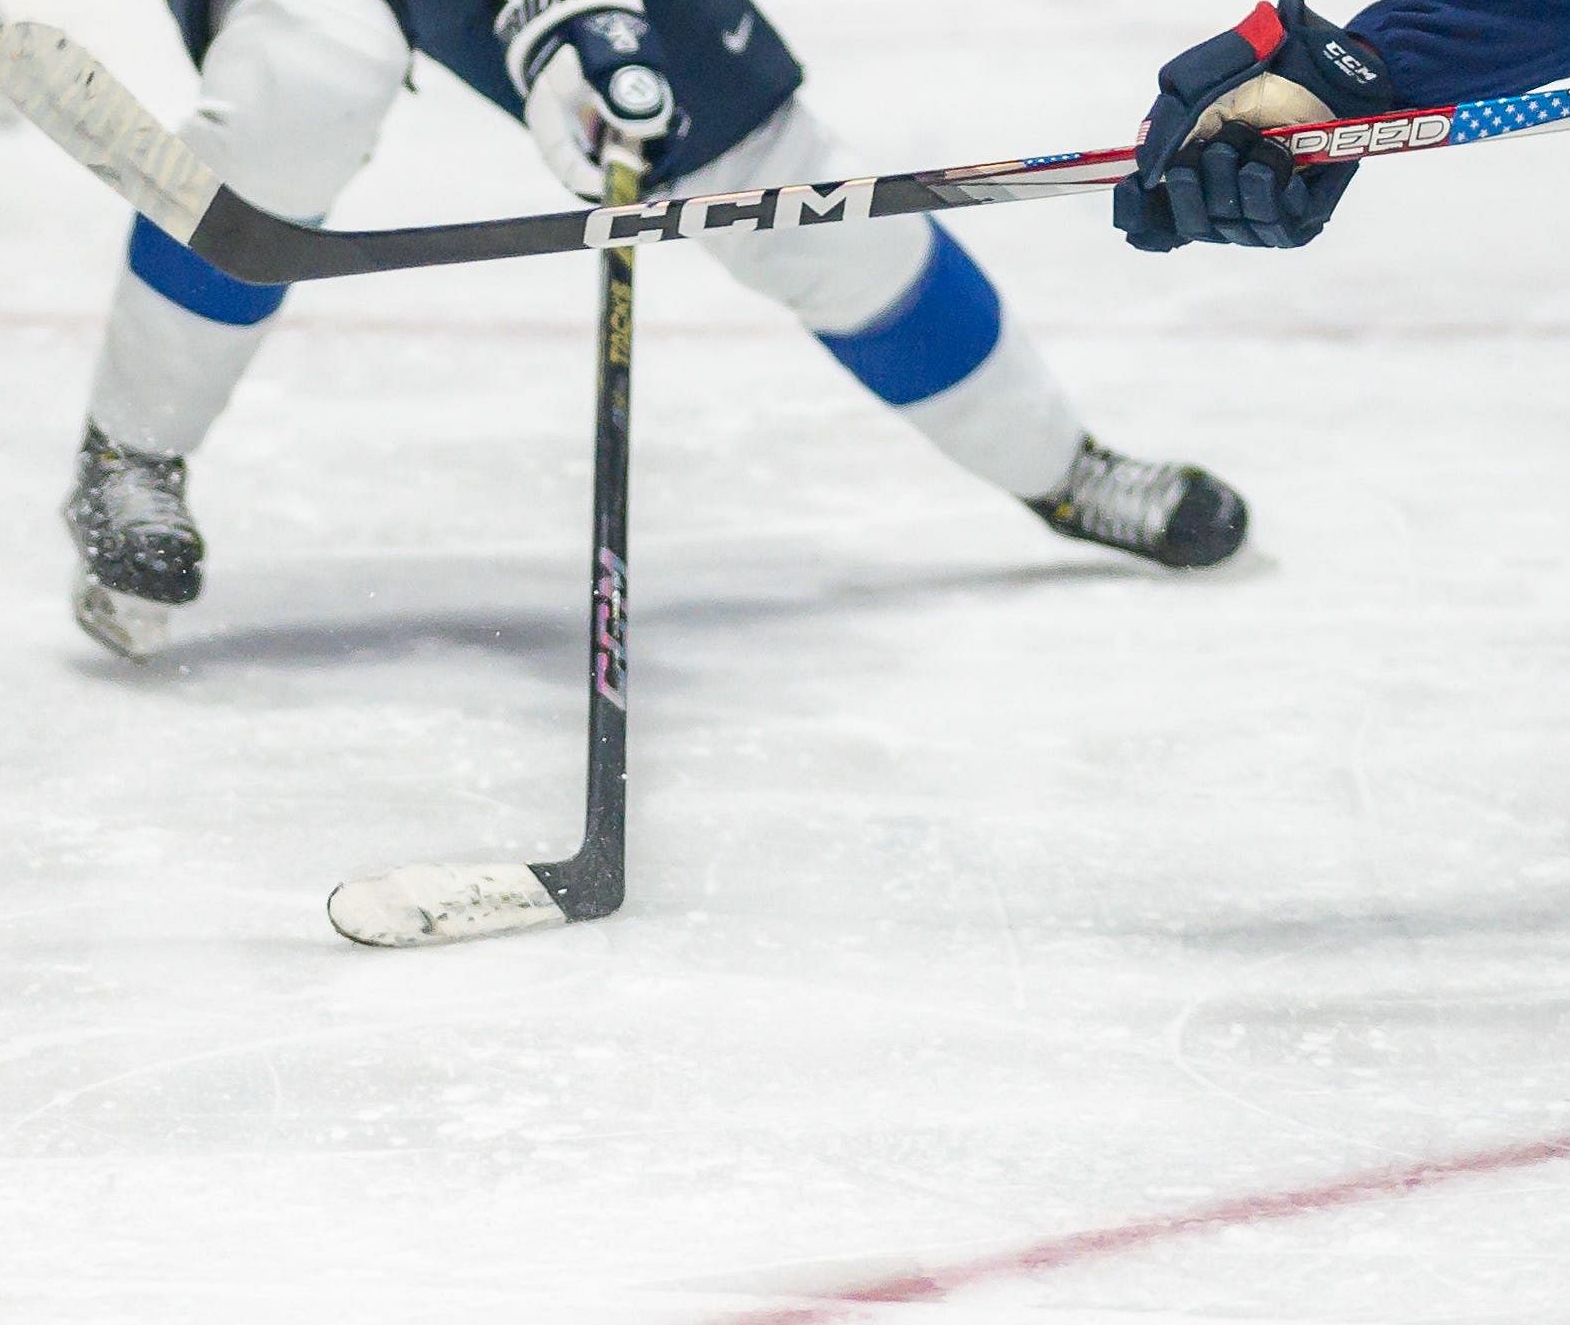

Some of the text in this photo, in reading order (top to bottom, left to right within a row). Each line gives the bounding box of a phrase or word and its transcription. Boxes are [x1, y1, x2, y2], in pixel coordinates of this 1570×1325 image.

[1324, 40, 1378, 82] CCM
[1280, 114, 1452, 158] PEED
[583, 176, 879, 249] CCM
